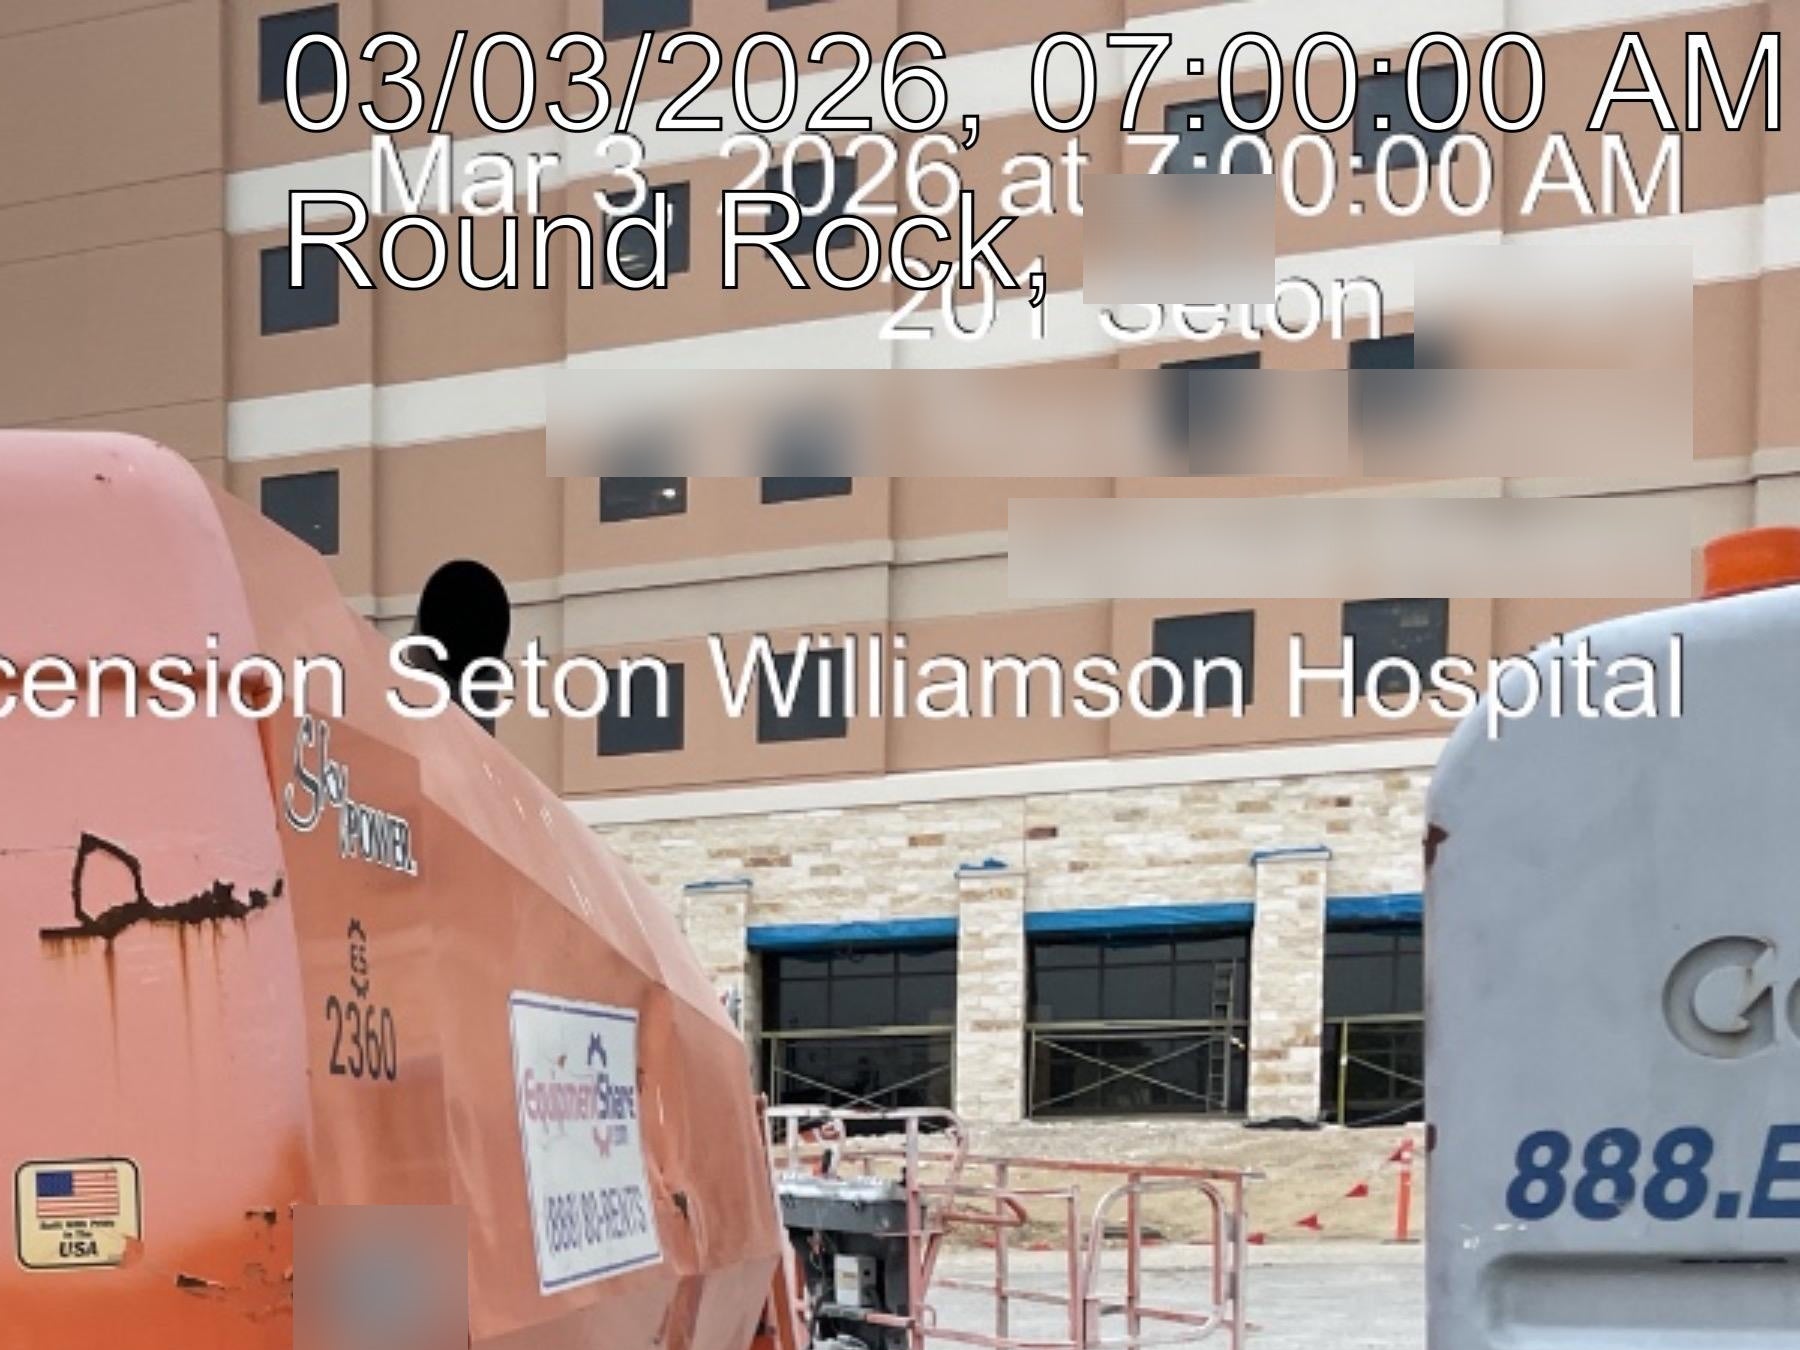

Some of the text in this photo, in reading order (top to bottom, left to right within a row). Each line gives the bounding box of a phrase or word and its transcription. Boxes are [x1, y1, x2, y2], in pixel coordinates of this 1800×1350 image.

[325, 995, 398, 1083] 2360
[1662, 935, 1800, 1058] G
[1505, 1125, 1800, 1221] 888.E
[59, 1240, 98, 1258] USA
